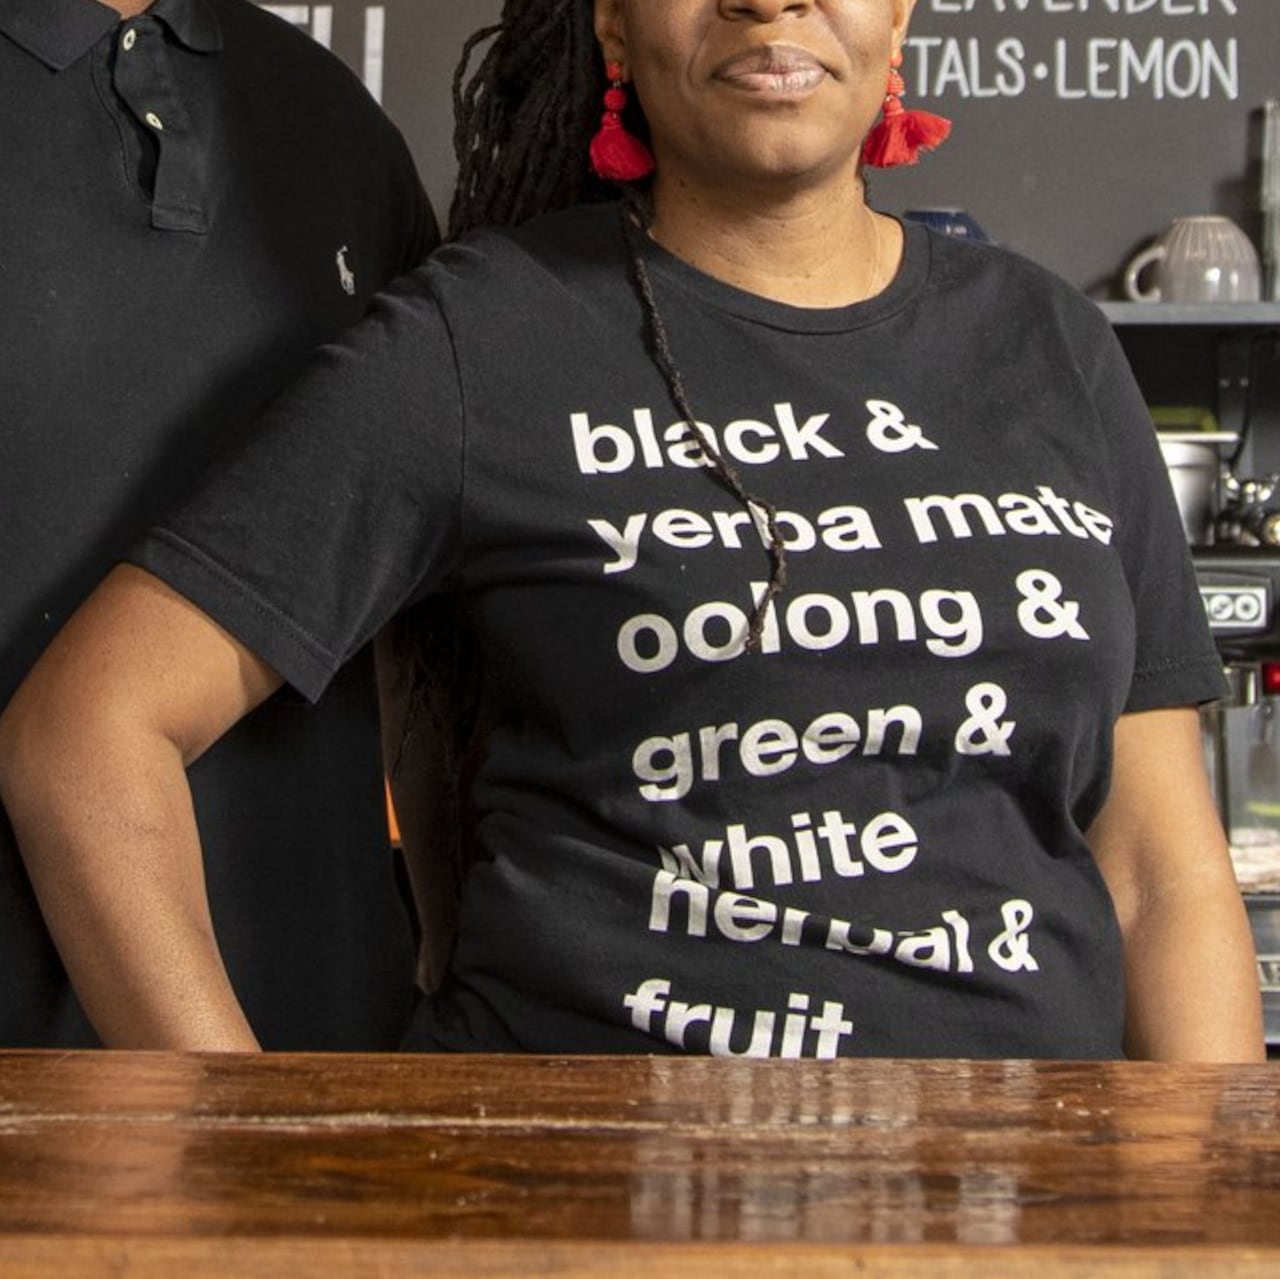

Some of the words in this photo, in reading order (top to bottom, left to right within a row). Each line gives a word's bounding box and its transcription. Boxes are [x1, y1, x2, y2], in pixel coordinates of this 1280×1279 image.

[902, 33, 1026, 98] TALS
[1055, 37, 1238, 100] LEMON
[570, 402, 845, 474] black
[865, 399, 939, 453] &
[587, 500, 883, 574] yerba
[903, 485, 1114, 545] mate
[617, 581, 983, 672] oolong
[1015, 568, 1090, 640] &
[632, 704, 923, 802] green
[954, 682, 1016, 755] &
[660, 810, 919, 890] white
[987, 899, 1039, 972] &
[623, 977, 853, 1059] fruit
